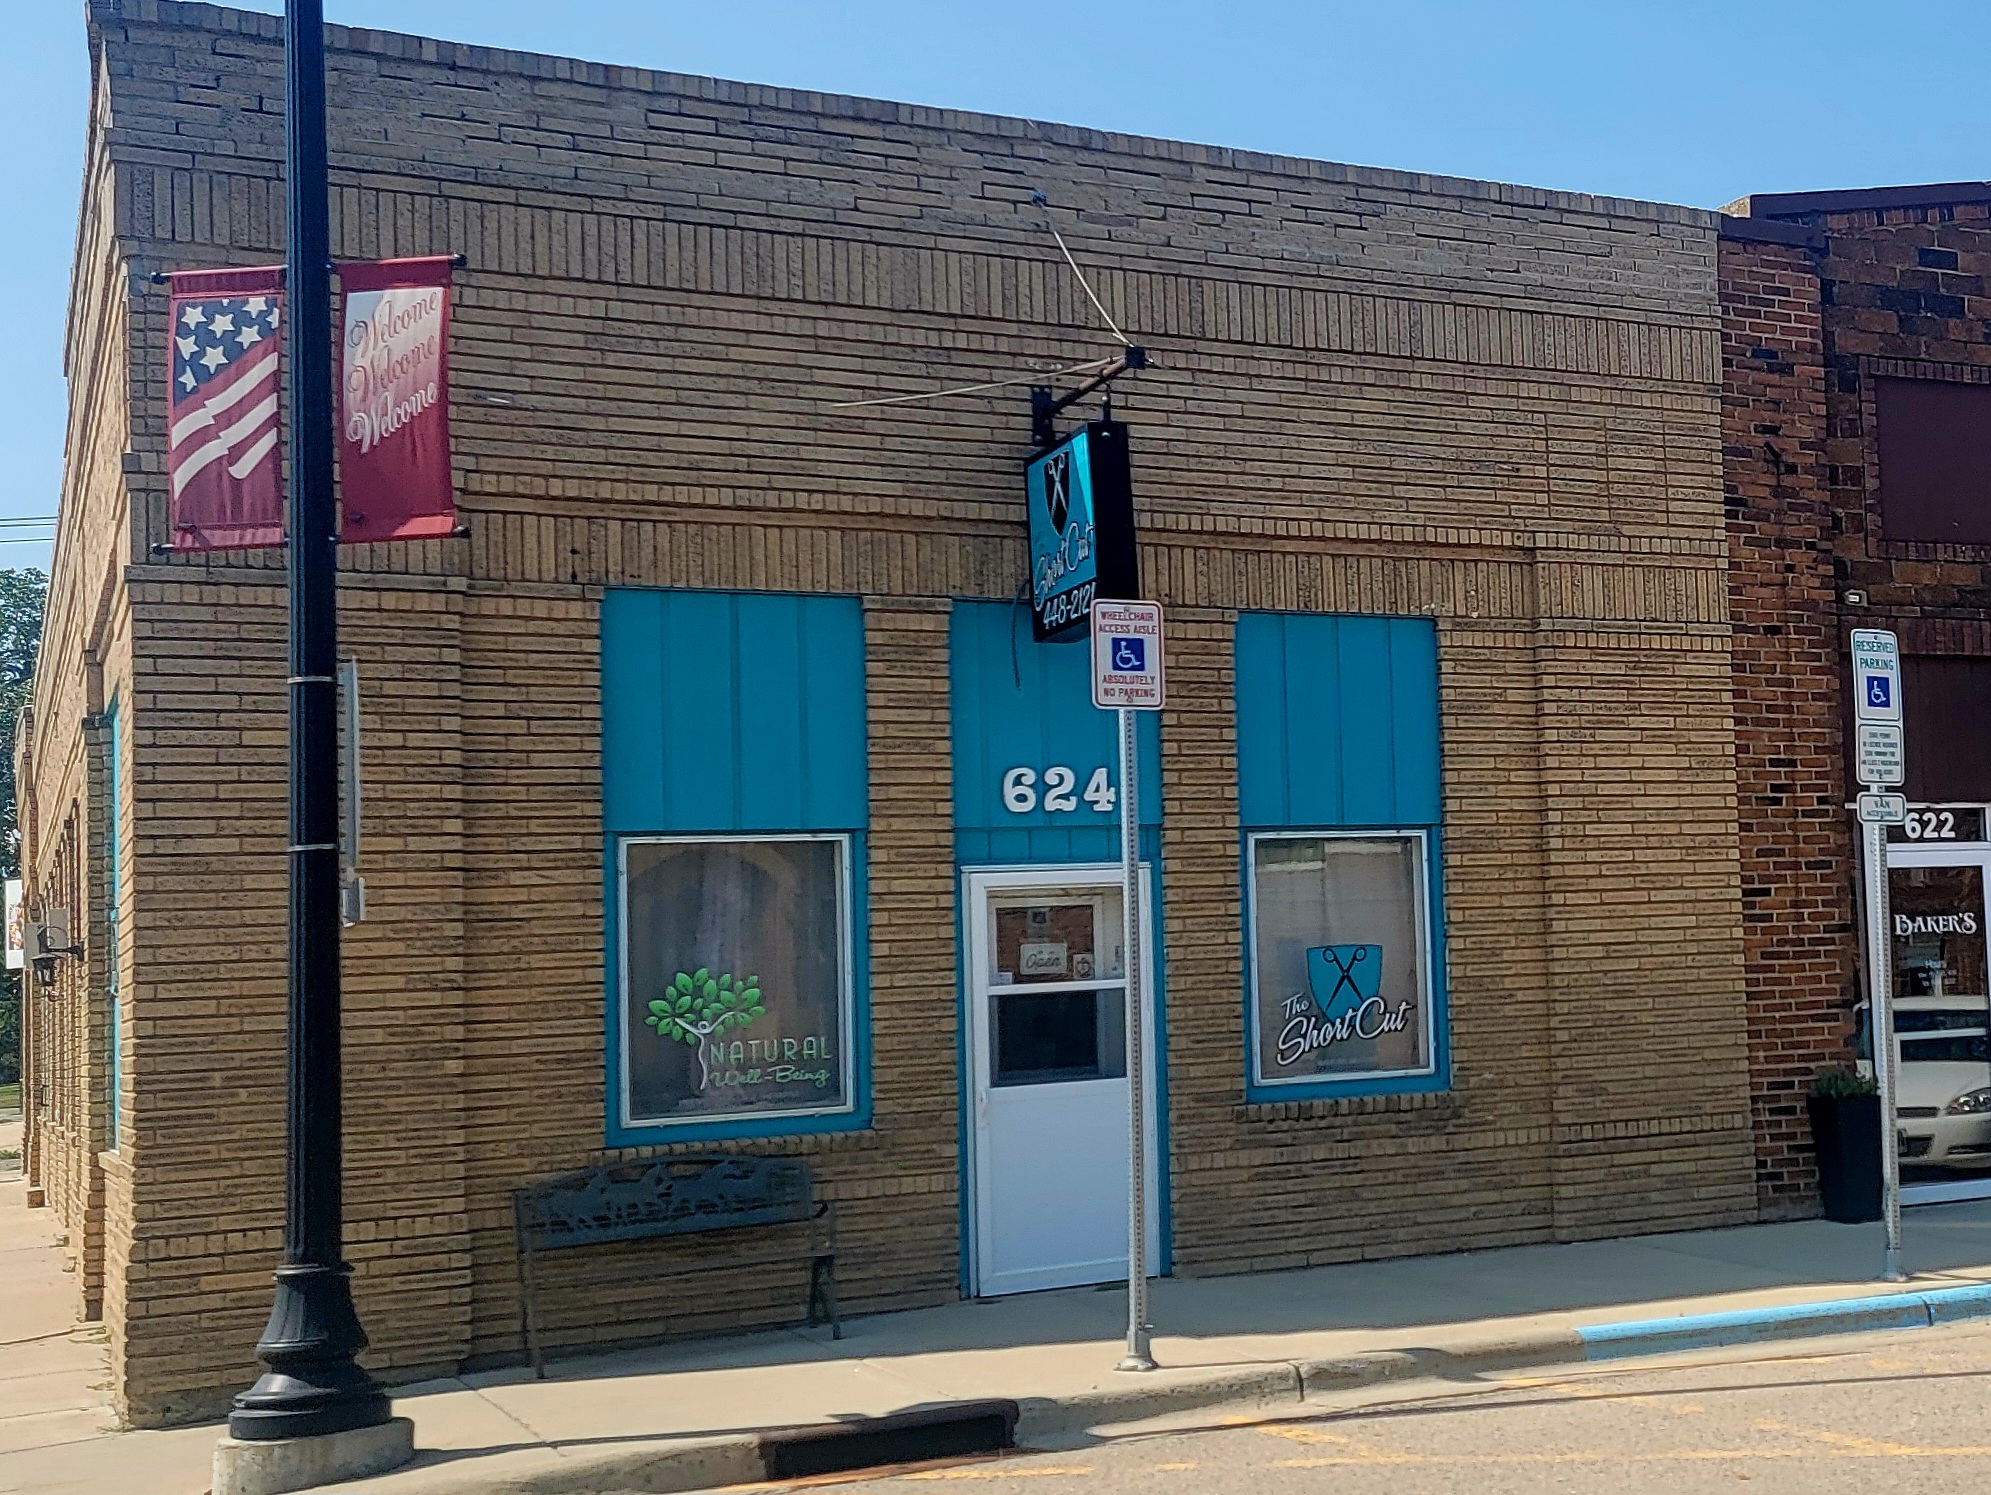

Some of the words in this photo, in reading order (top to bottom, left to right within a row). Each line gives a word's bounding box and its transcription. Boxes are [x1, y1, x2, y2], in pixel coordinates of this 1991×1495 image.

[347, 291, 437, 358] Welcome
[346, 335, 436, 402] Welcome
[345, 381, 438, 454] Welcome
[1033, 539, 1067, 612] Short
[1065, 522, 1095, 571] Cut
[1101, 611, 1154, 622] WHEELCHAIR
[1099, 623, 1131, 634] ACCESS
[1133, 624, 1158, 635] AISLE
[1855, 640, 1895, 654] RESERVED
[1859, 657, 1895, 671] PARKING
[1102, 674, 1156, 686] ABSOLUTELY
[1103, 687, 1116, 698] NO
[1118, 687, 1156, 699] PARKING
[1003, 766, 1117, 813] 624
[1873, 800, 1891, 809] VAN
[1904, 811, 1956, 839] 622
[1894, 912, 1978, 936] BAKER'S
[1025, 951, 1061, 969] Open
[1281, 992, 1310, 1020] The
[1276, 1007, 1358, 1065] Short
[1355, 997, 1414, 1040] Cut
[710, 1036, 834, 1065] NATURAL
[709, 1065, 832, 1088] Well-Being
